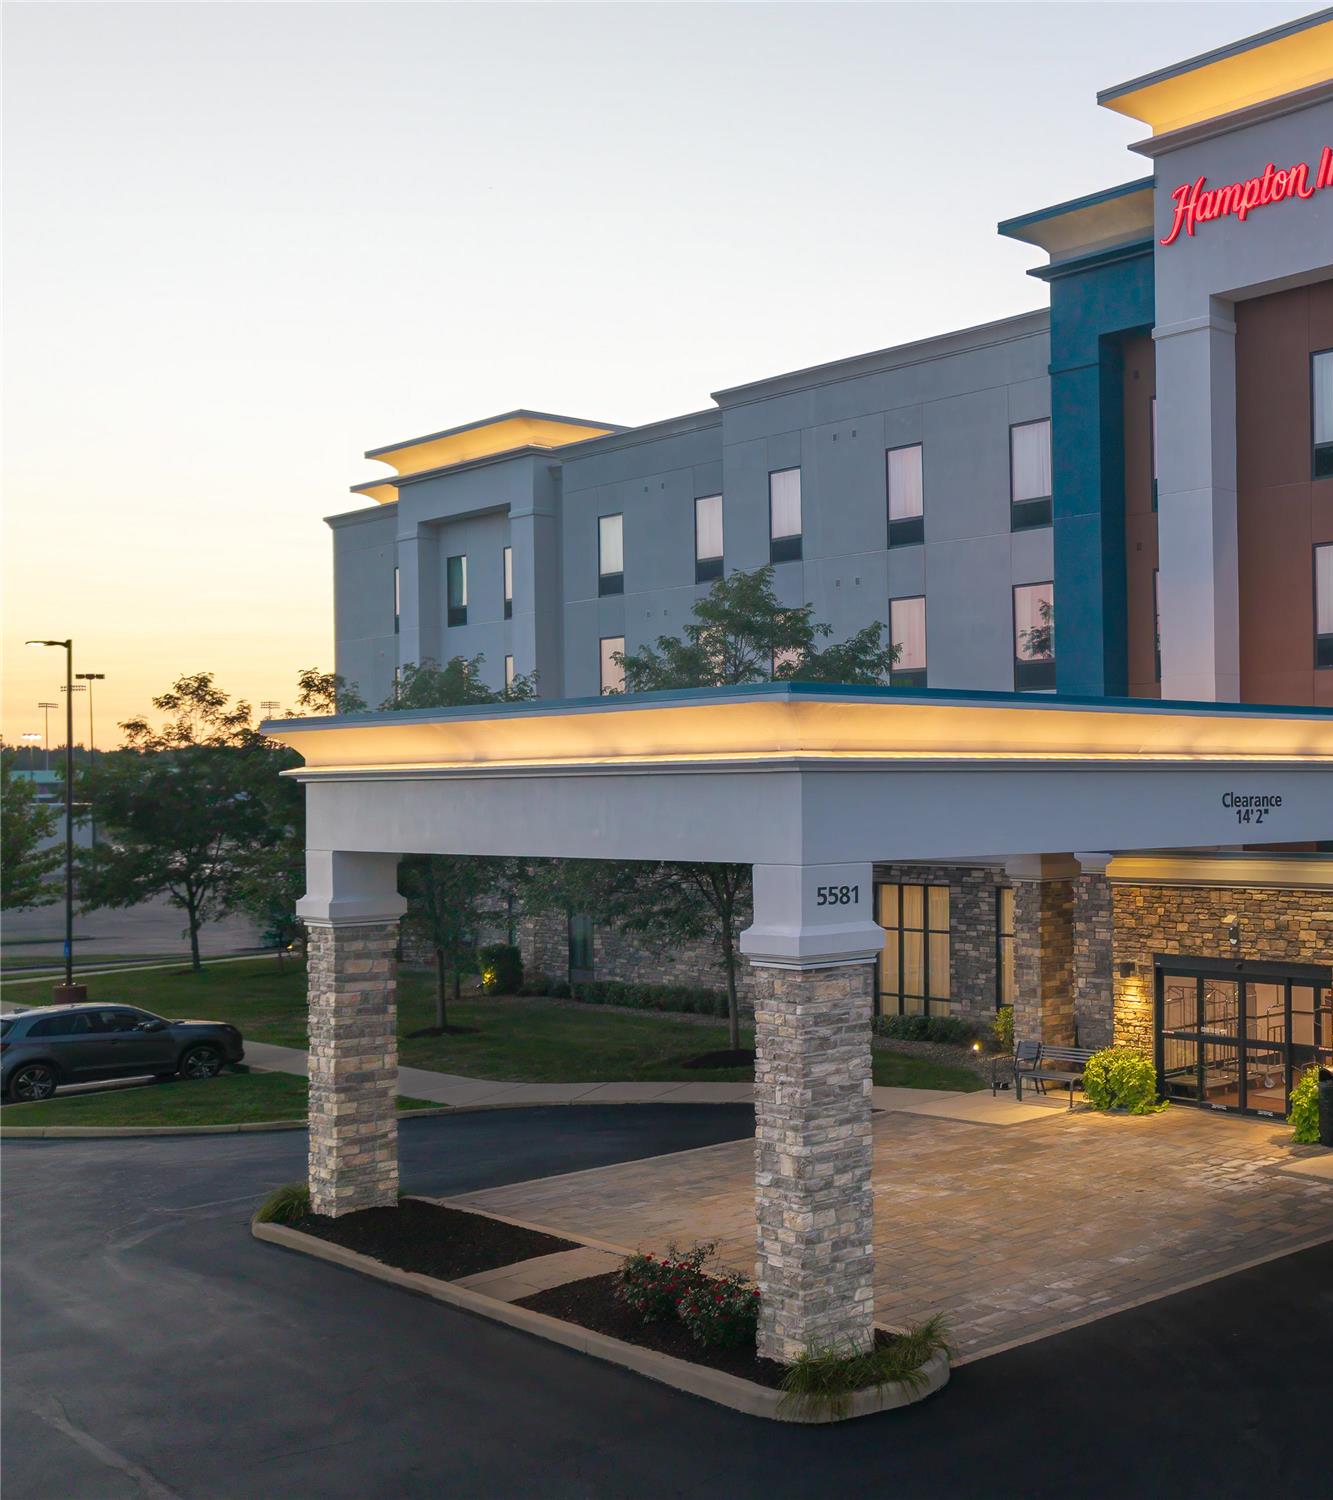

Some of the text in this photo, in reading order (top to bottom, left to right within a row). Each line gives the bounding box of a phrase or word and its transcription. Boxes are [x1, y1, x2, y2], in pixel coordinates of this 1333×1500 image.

[1160, 162, 1315, 246] Hampton
[1222, 791, 1282, 808] Clearance
[816, 885, 859, 906] 5581
